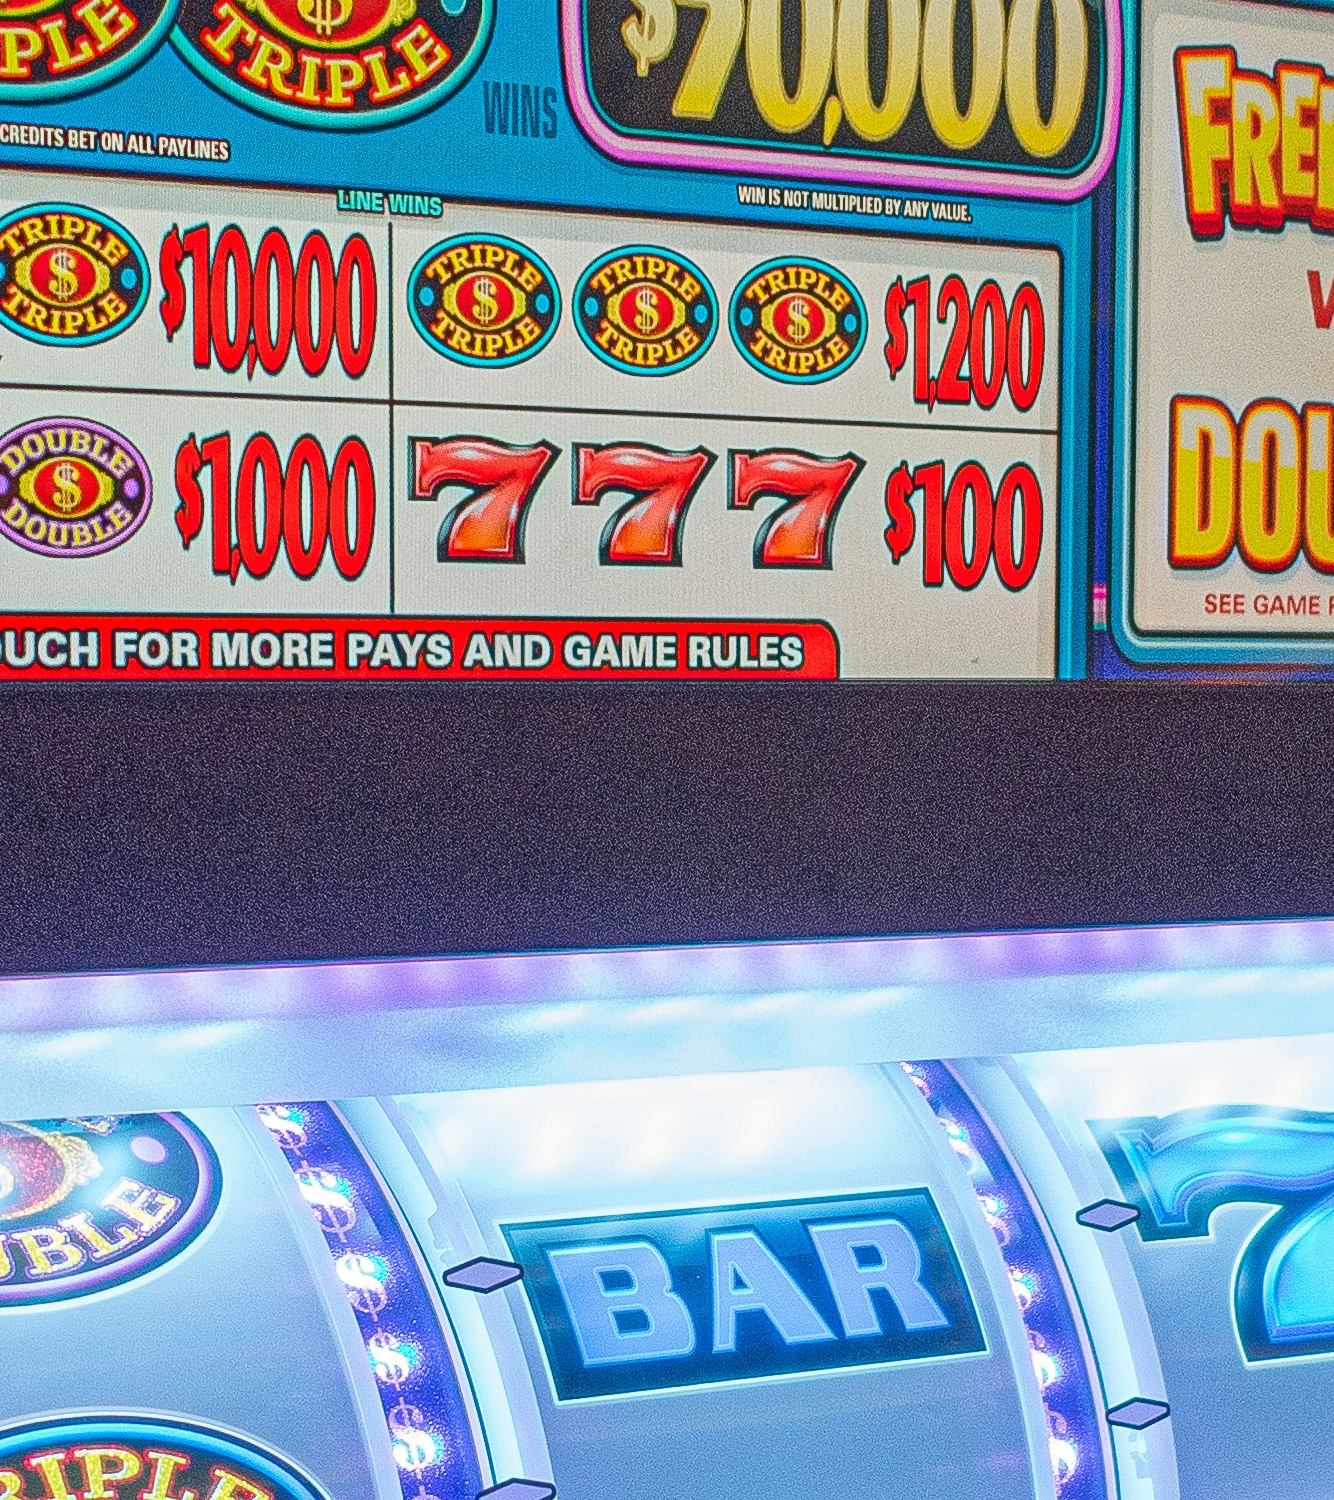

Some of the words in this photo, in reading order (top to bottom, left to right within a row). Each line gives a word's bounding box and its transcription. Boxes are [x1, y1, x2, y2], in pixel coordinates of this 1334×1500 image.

[483, 80, 558, 140] WINS
[0, 123, 64, 148] CREDITS
[68, 129, 97, 150] BET
[101, 132, 124, 151] ON
[128, 133, 154, 154] ALL
[159, 137, 229, 160] PAYLINES
[337, 189, 384, 212] LINE
[386, 192, 443, 217] WINS
[737, 184, 766, 206] WIN
[768, 186, 782, 208] IS
[783, 187, 809, 210] NOT
[812, 190, 882, 216] MULTIPLIED
[885, 196, 902, 216] BY
[903, 198, 929, 219] ANY
[426, 244, 543, 289] TRIPLE
[592, 255, 702, 302] TRIPLE
[746, 265, 851, 312] TRIPLE
[3, 285, 128, 336] TRIPLE
[161, 223, 377, 380] $10,000
[433, 311, 542, 357] TRIPLE
[595, 324, 702, 366] TRIPLE
[751, 333, 851, 375] TRIPLE
[884, 274, 1043, 412] $1,200
[2, 499, 133, 547] DOUBLE
[175, 431, 375, 585] $1,000
[408, 435, 562, 565] 7
[571, 441, 718, 567] 7
[727, 448, 867, 570] 7
[884, 459, 1043, 591] $100
[1204, 593, 1246, 615] SEE
[1253, 594, 1320, 617] GAME
[115, 629, 199, 669] FOR
[212, 630, 334, 670] MORE
[348, 631, 453, 670] PAYS
[464, 632, 554, 670] AND
[564, 633, 678, 670] GAME
[687, 633, 804, 670] RULES
[550, 1210, 953, 1369] BAR
